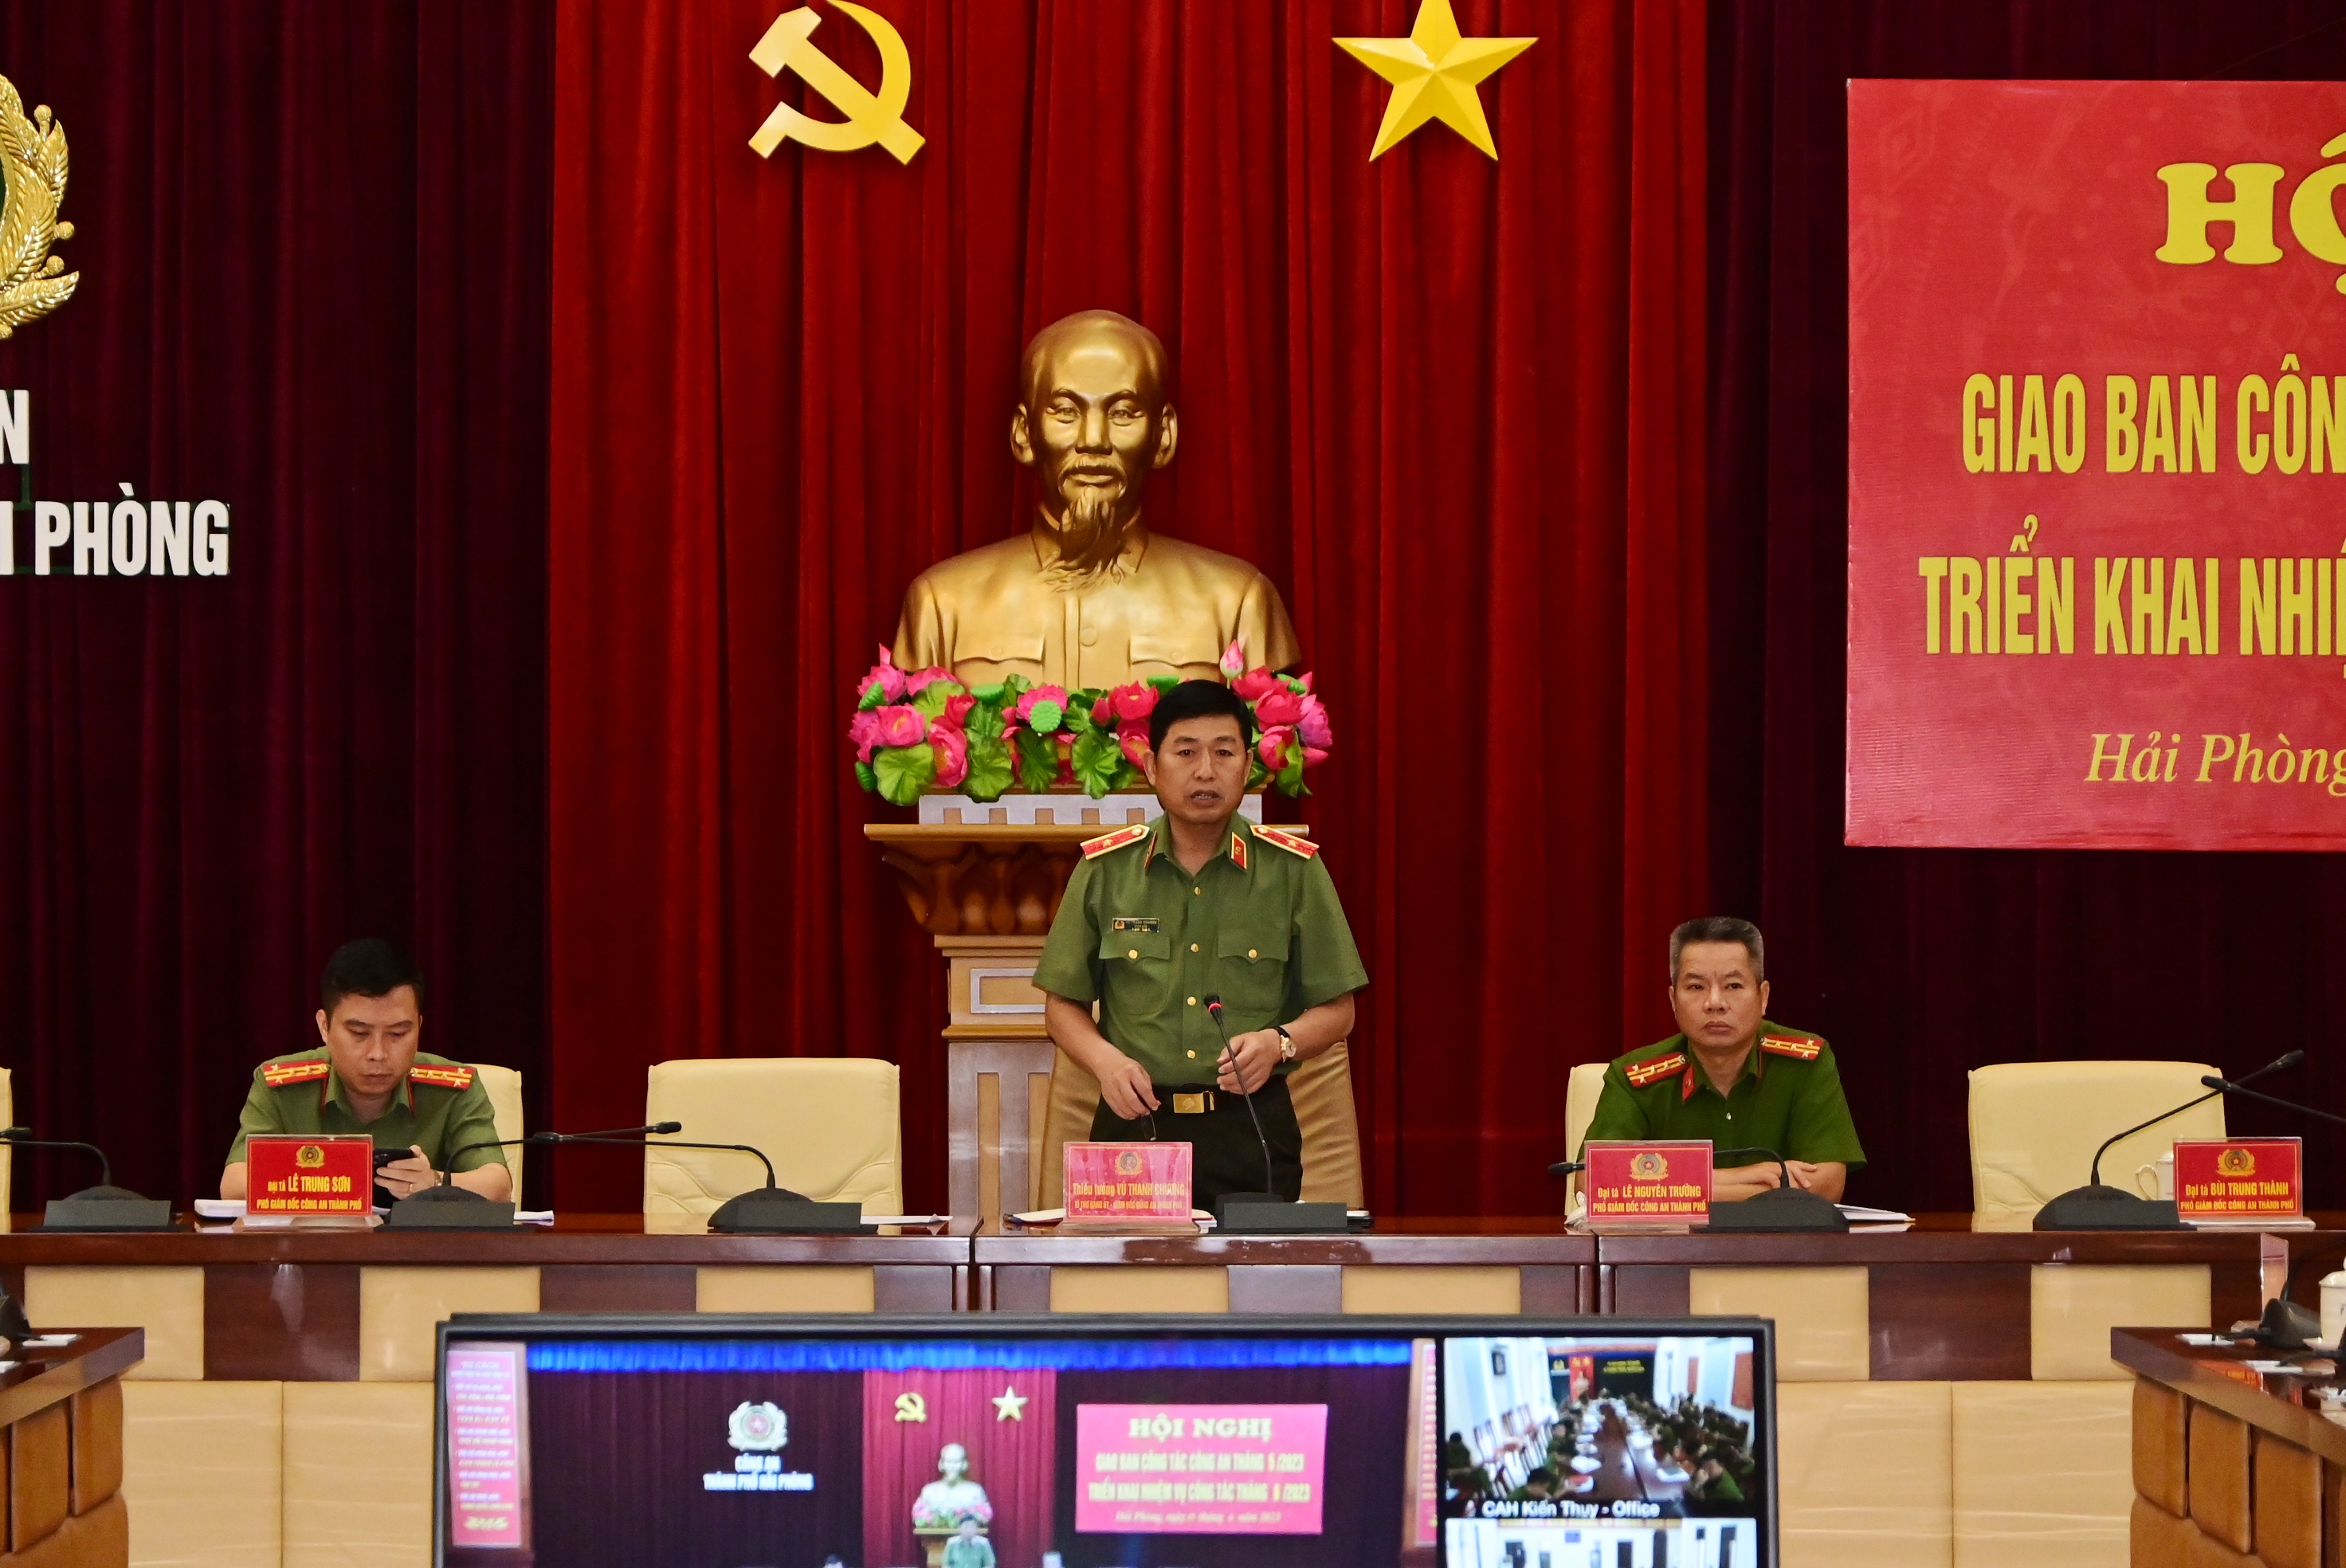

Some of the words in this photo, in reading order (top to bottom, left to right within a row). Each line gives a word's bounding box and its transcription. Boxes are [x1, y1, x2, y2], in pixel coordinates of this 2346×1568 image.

[1962, 373, 2087, 474] GIAO
[2106, 374, 2217, 474] BAN
[35, 482, 230, 576] PHÒNG
[1918, 514, 2074, 655] TRIỂN
[2094, 557, 2219, 655] KHAI
[2085, 731, 2181, 783] Hải
[288, 1172, 299, 1192] LÊ
[300, 1175, 330, 1192] TRUNG
[332, 1174, 351, 1192] SƠN
[1128, 1182, 1152, 1195] THANH
[1598, 1187, 1610, 1200] Đại
[1611, 1186, 1619, 1198] tá
[1622, 1183, 1633, 1198] LÊ
[1669, 1182, 1701, 1198] TRƯỜNG
[2185, 1184, 2199, 1198] Đại
[2200, 1184, 2209, 1196] tá
[2211, 1179, 2226, 1196] BÙI
[2227, 1182, 2258, 1196] TRUNG
[2259, 1179, 2289, 1196] THÀNH
[1593, 1201, 1606, 1212] PHÓ
[1607, 1201, 1625, 1212] GIÁM
[1626, 1199, 1639, 1212] ĐỐC
[1640, 1201, 1658, 1212] CÔNG
[1660, 1202, 1669, 1212] AN
[1670, 1201, 1692, 1212] THÀNH
[1693, 1198, 1706, 1212] PHỐ
[2180, 1200, 2194, 1209] PHÓ
[2195, 1200, 2212, 1209] GIÁM
[2228, 1199, 2246, 1209] CÔNG
[2247, 1201, 2257, 1209] AN
[2258, 1199, 2279, 1209] THÀNH
[2280, 1198, 2294, 1209] PHỐ
[1129, 1413, 1184, 1443] HỘI
[1193, 1417, 1272, 1443] NGHỊ
[1482, 1500, 1519, 1518] CAH
[1521, 1499, 1557, 1518] Kiến
[1612, 1500, 1661, 1518] Office
